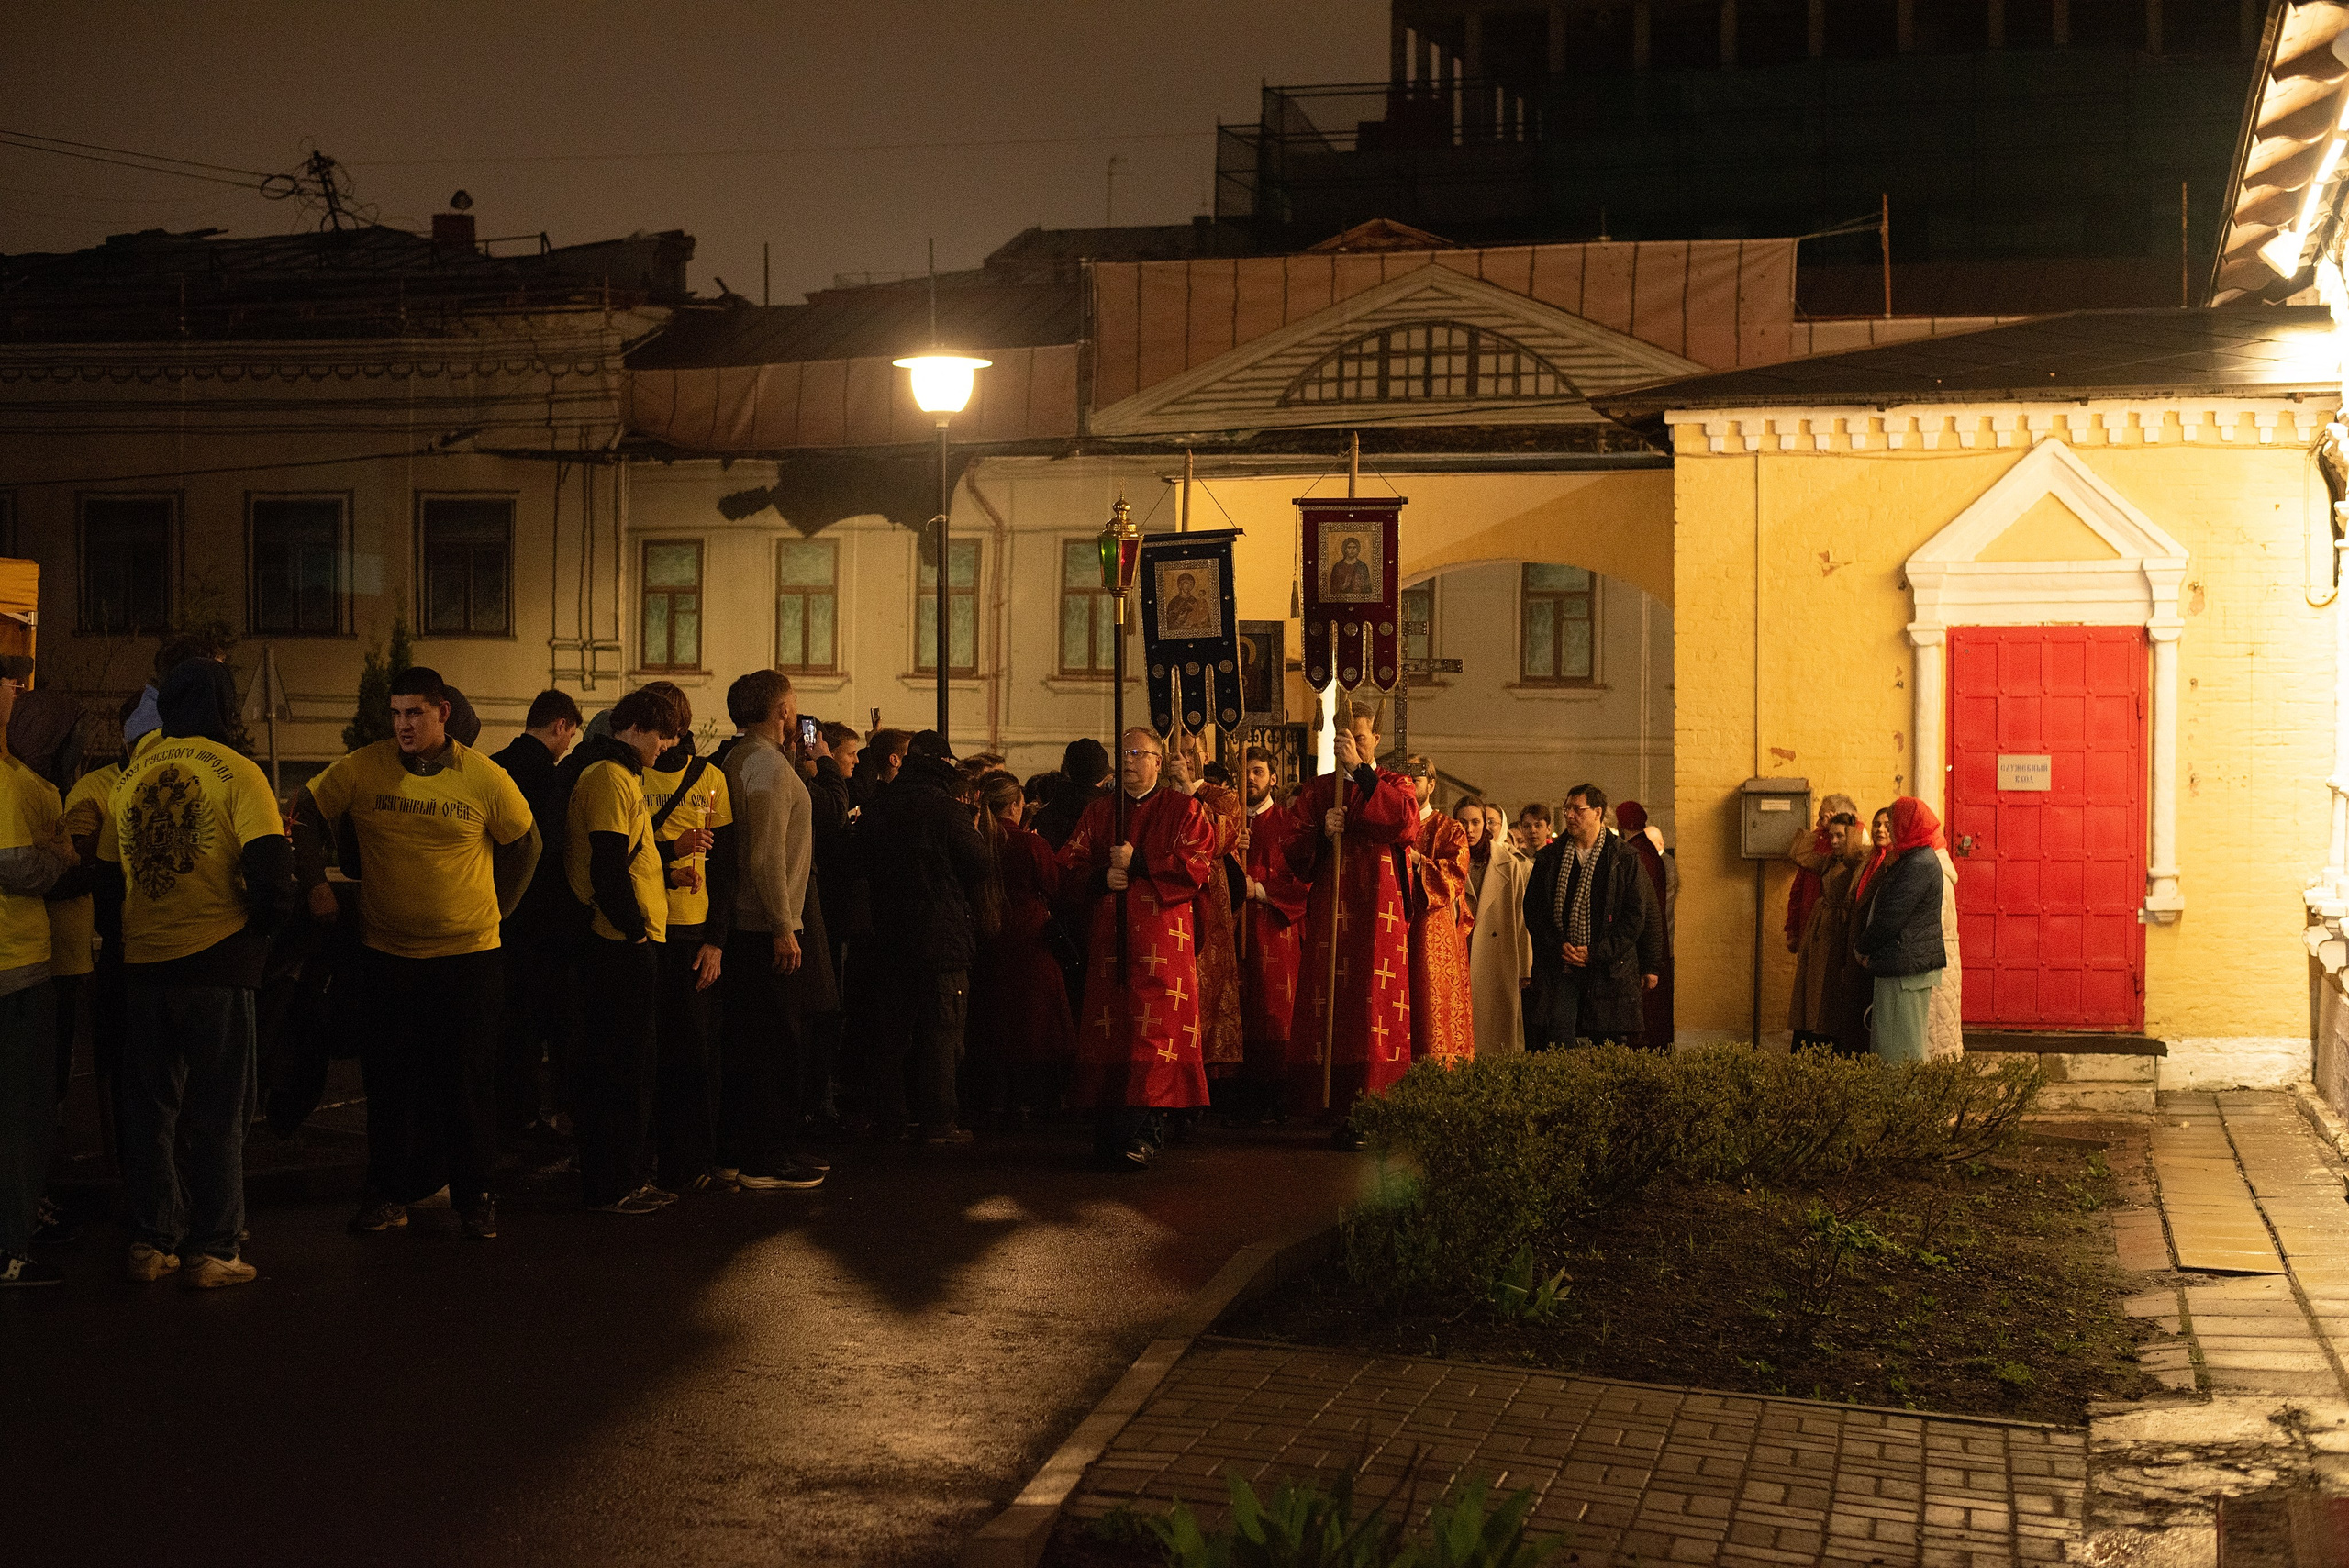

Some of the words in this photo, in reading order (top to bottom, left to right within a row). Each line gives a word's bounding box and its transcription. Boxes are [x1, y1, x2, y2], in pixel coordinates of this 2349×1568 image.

[144, 748, 195, 768] РУССКОГО
[195, 750, 234, 783] НАРОДА
[373, 794, 437, 817] ДВУГЛАВЫЙ
[442, 801, 470, 821] ОРЁЛ
